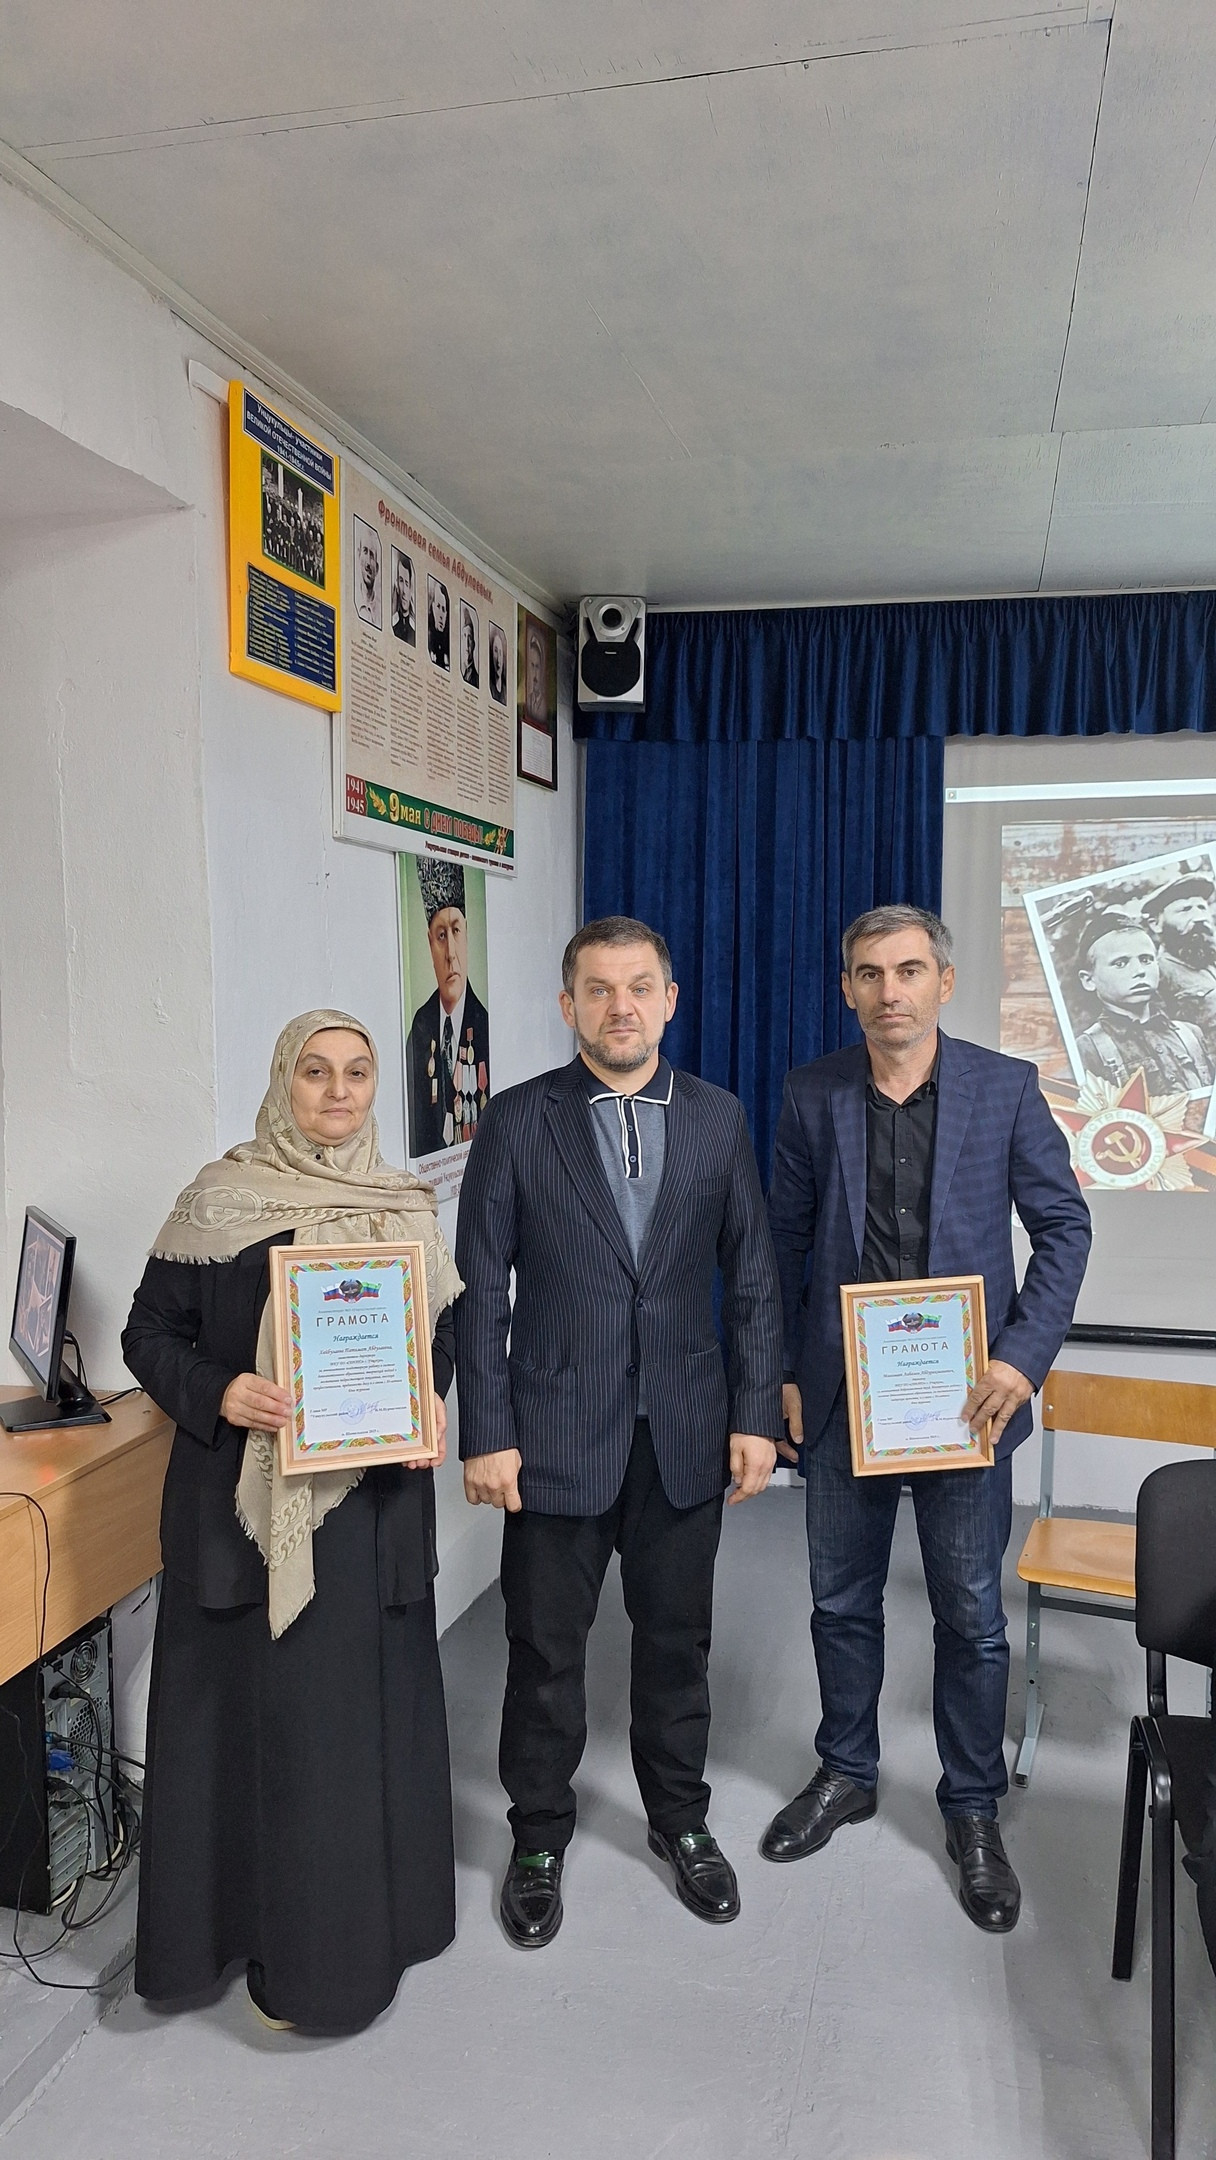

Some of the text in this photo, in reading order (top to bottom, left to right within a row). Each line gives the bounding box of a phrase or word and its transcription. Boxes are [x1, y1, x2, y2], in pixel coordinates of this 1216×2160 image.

[246, 411, 332, 480] ВЕЛИКОЙ ОТЕЧЕСТВЕННОЙ ВОЙНЫ
[378, 499, 426, 552] Фронтовая
[428, 542, 450, 571] семья
[346, 777, 364, 795] 1941
[346, 795, 364, 814] 1945
[389, 793, 400, 822] 9
[400, 805, 421, 826] мая
[424, 807, 430, 829] С
[430, 810, 451, 835] ДНЕМ
[1081, 1111, 1162, 1183] ОТЕЧЕСТВЕННАЯ ВОЙНА
[316, 1313, 389, 1327] ГРАМОТА
[333, 1333, 379, 1343] Награждается
[881, 1341, 949, 1355] ГРАМОТА
[896, 1359, 939, 1368] Награждается
